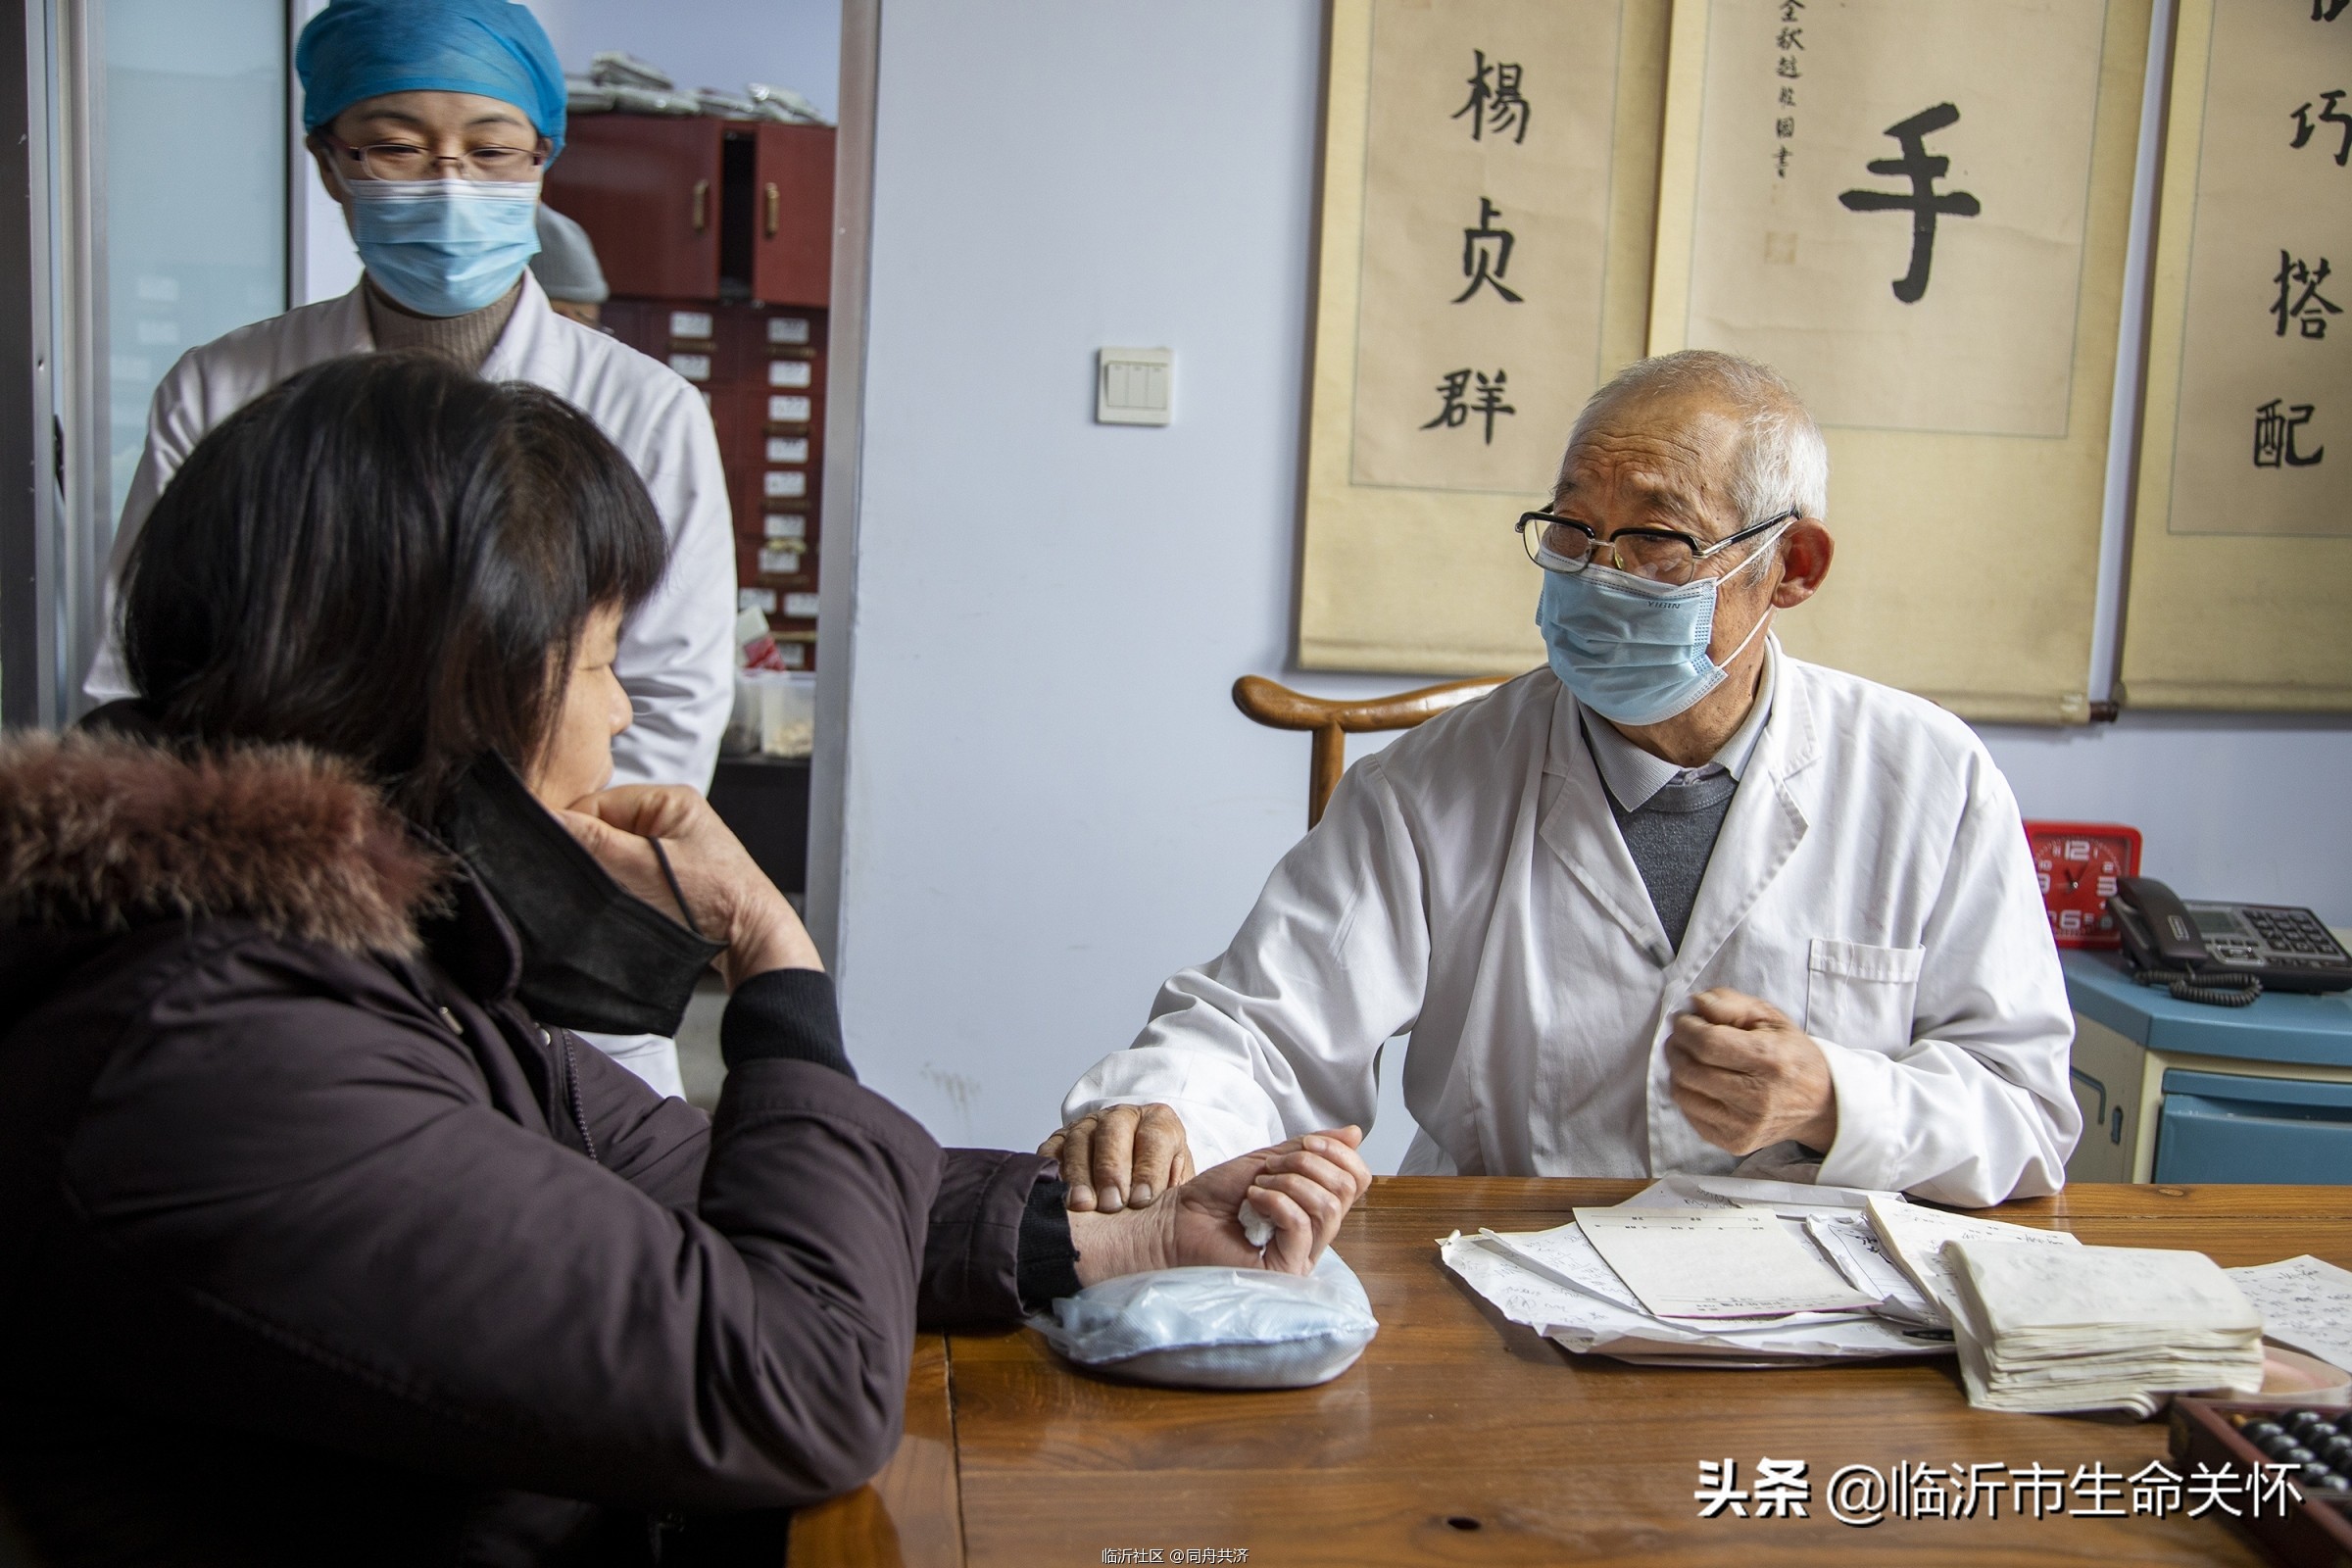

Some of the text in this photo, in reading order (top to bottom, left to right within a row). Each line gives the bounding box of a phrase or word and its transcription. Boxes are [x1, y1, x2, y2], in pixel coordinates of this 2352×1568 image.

[1838, 102, 1981, 304] 手
[2253, 0, 2352, 469] 巧搭配
[1647, 600, 1681, 610] YIBIN
[2064, 840, 2090, 861] 12
[2059, 909, 2082, 930] 6
